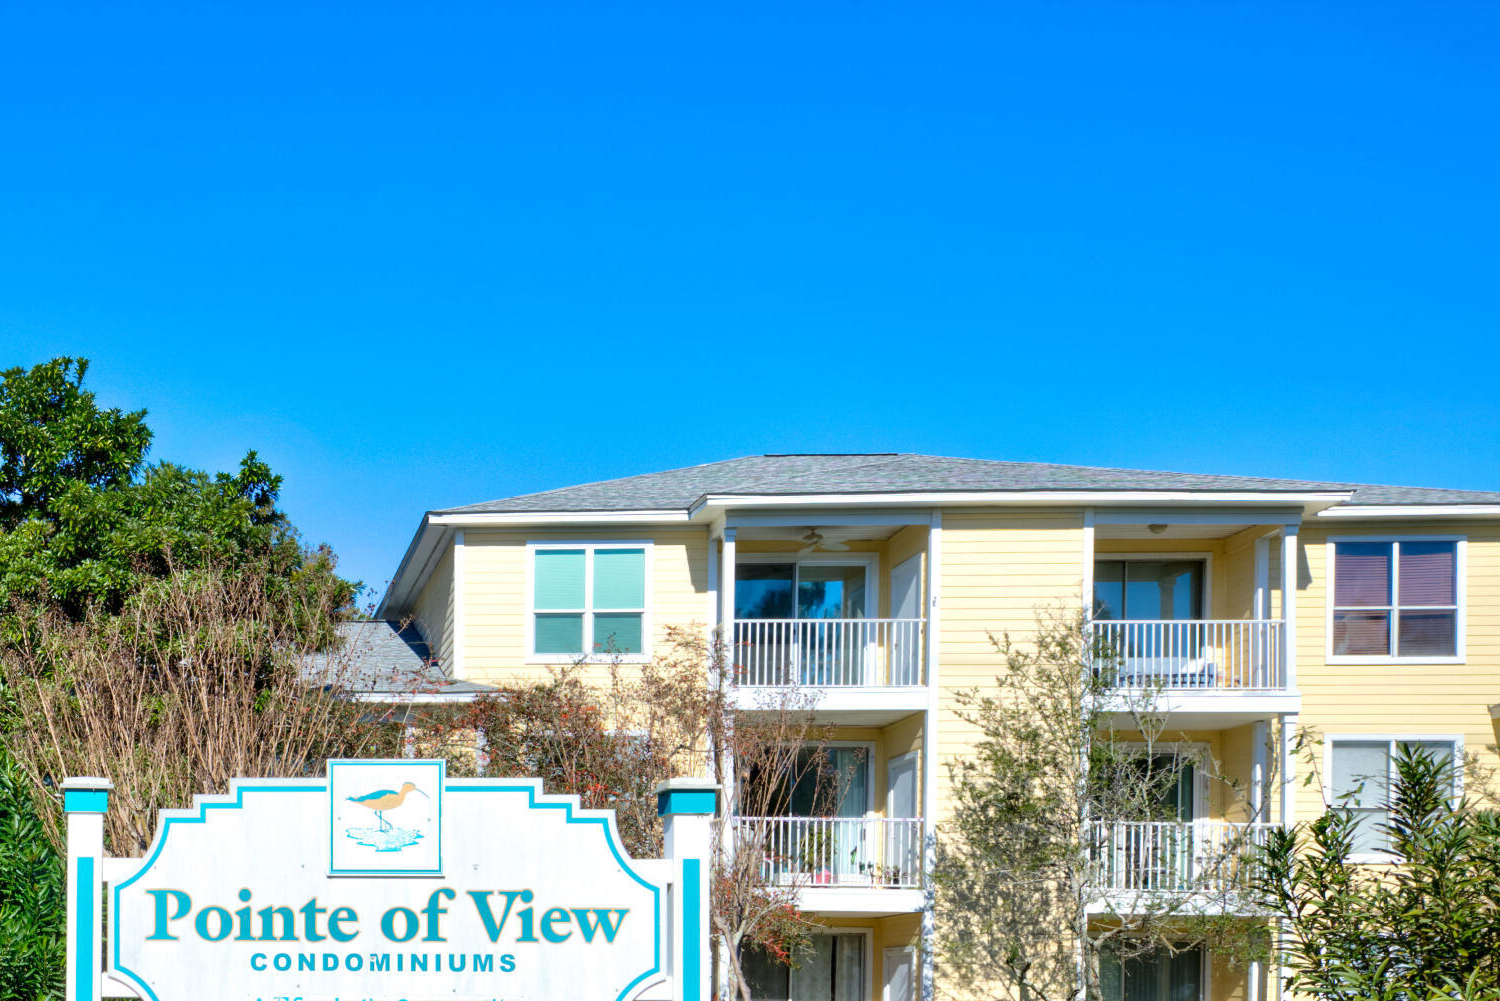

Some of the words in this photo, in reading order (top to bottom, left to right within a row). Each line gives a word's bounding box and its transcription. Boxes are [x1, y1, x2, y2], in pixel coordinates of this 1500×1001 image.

[145, 887, 360, 942] Pointe
[380, 886, 457, 943] of
[466, 888, 631, 944] View
[250, 952, 516, 973] CONDOMINIUMS
